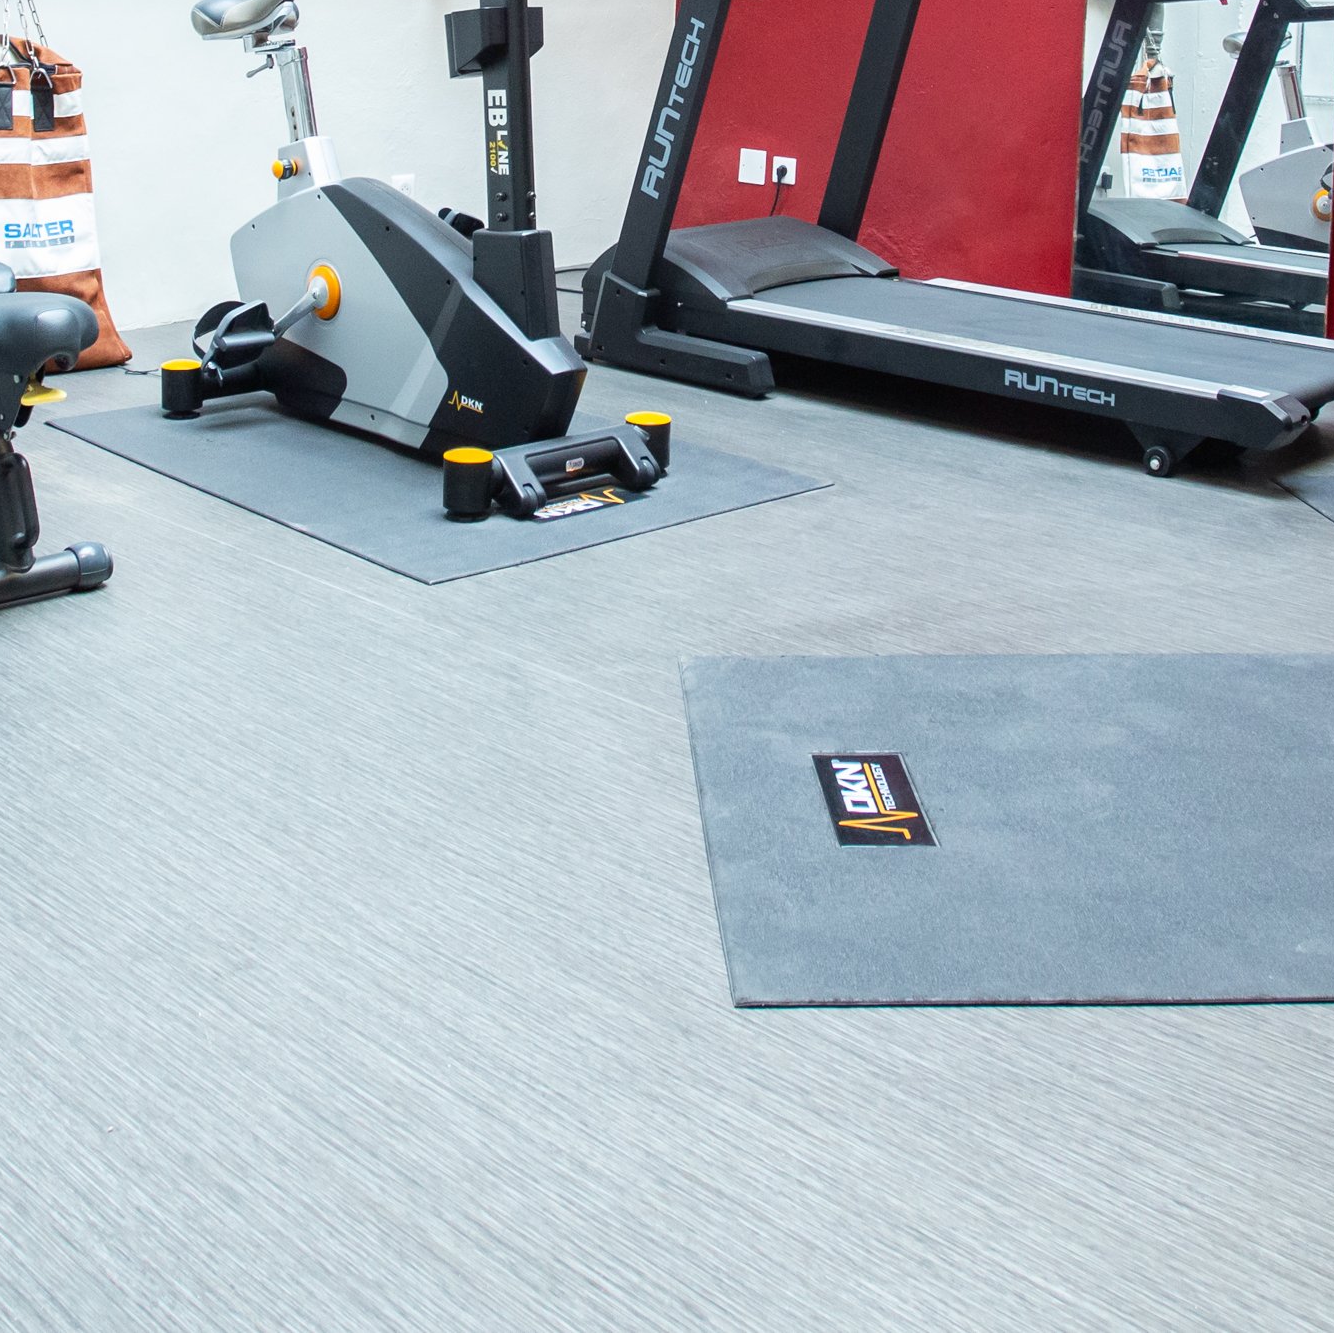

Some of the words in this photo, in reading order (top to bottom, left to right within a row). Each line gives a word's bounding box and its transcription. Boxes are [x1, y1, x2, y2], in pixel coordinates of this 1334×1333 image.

[487, 89, 508, 127] EB
[641, 17, 706, 199] RUNTECH
[489, 141, 497, 166] 2100
[4, 219, 74, 239] SALTER
[461, 395, 483, 411] DKN
[1004, 368, 1116, 408] RUNTECH
[831, 759, 878, 814] DKN
[870, 763, 897, 810] TECHNOLOGY
